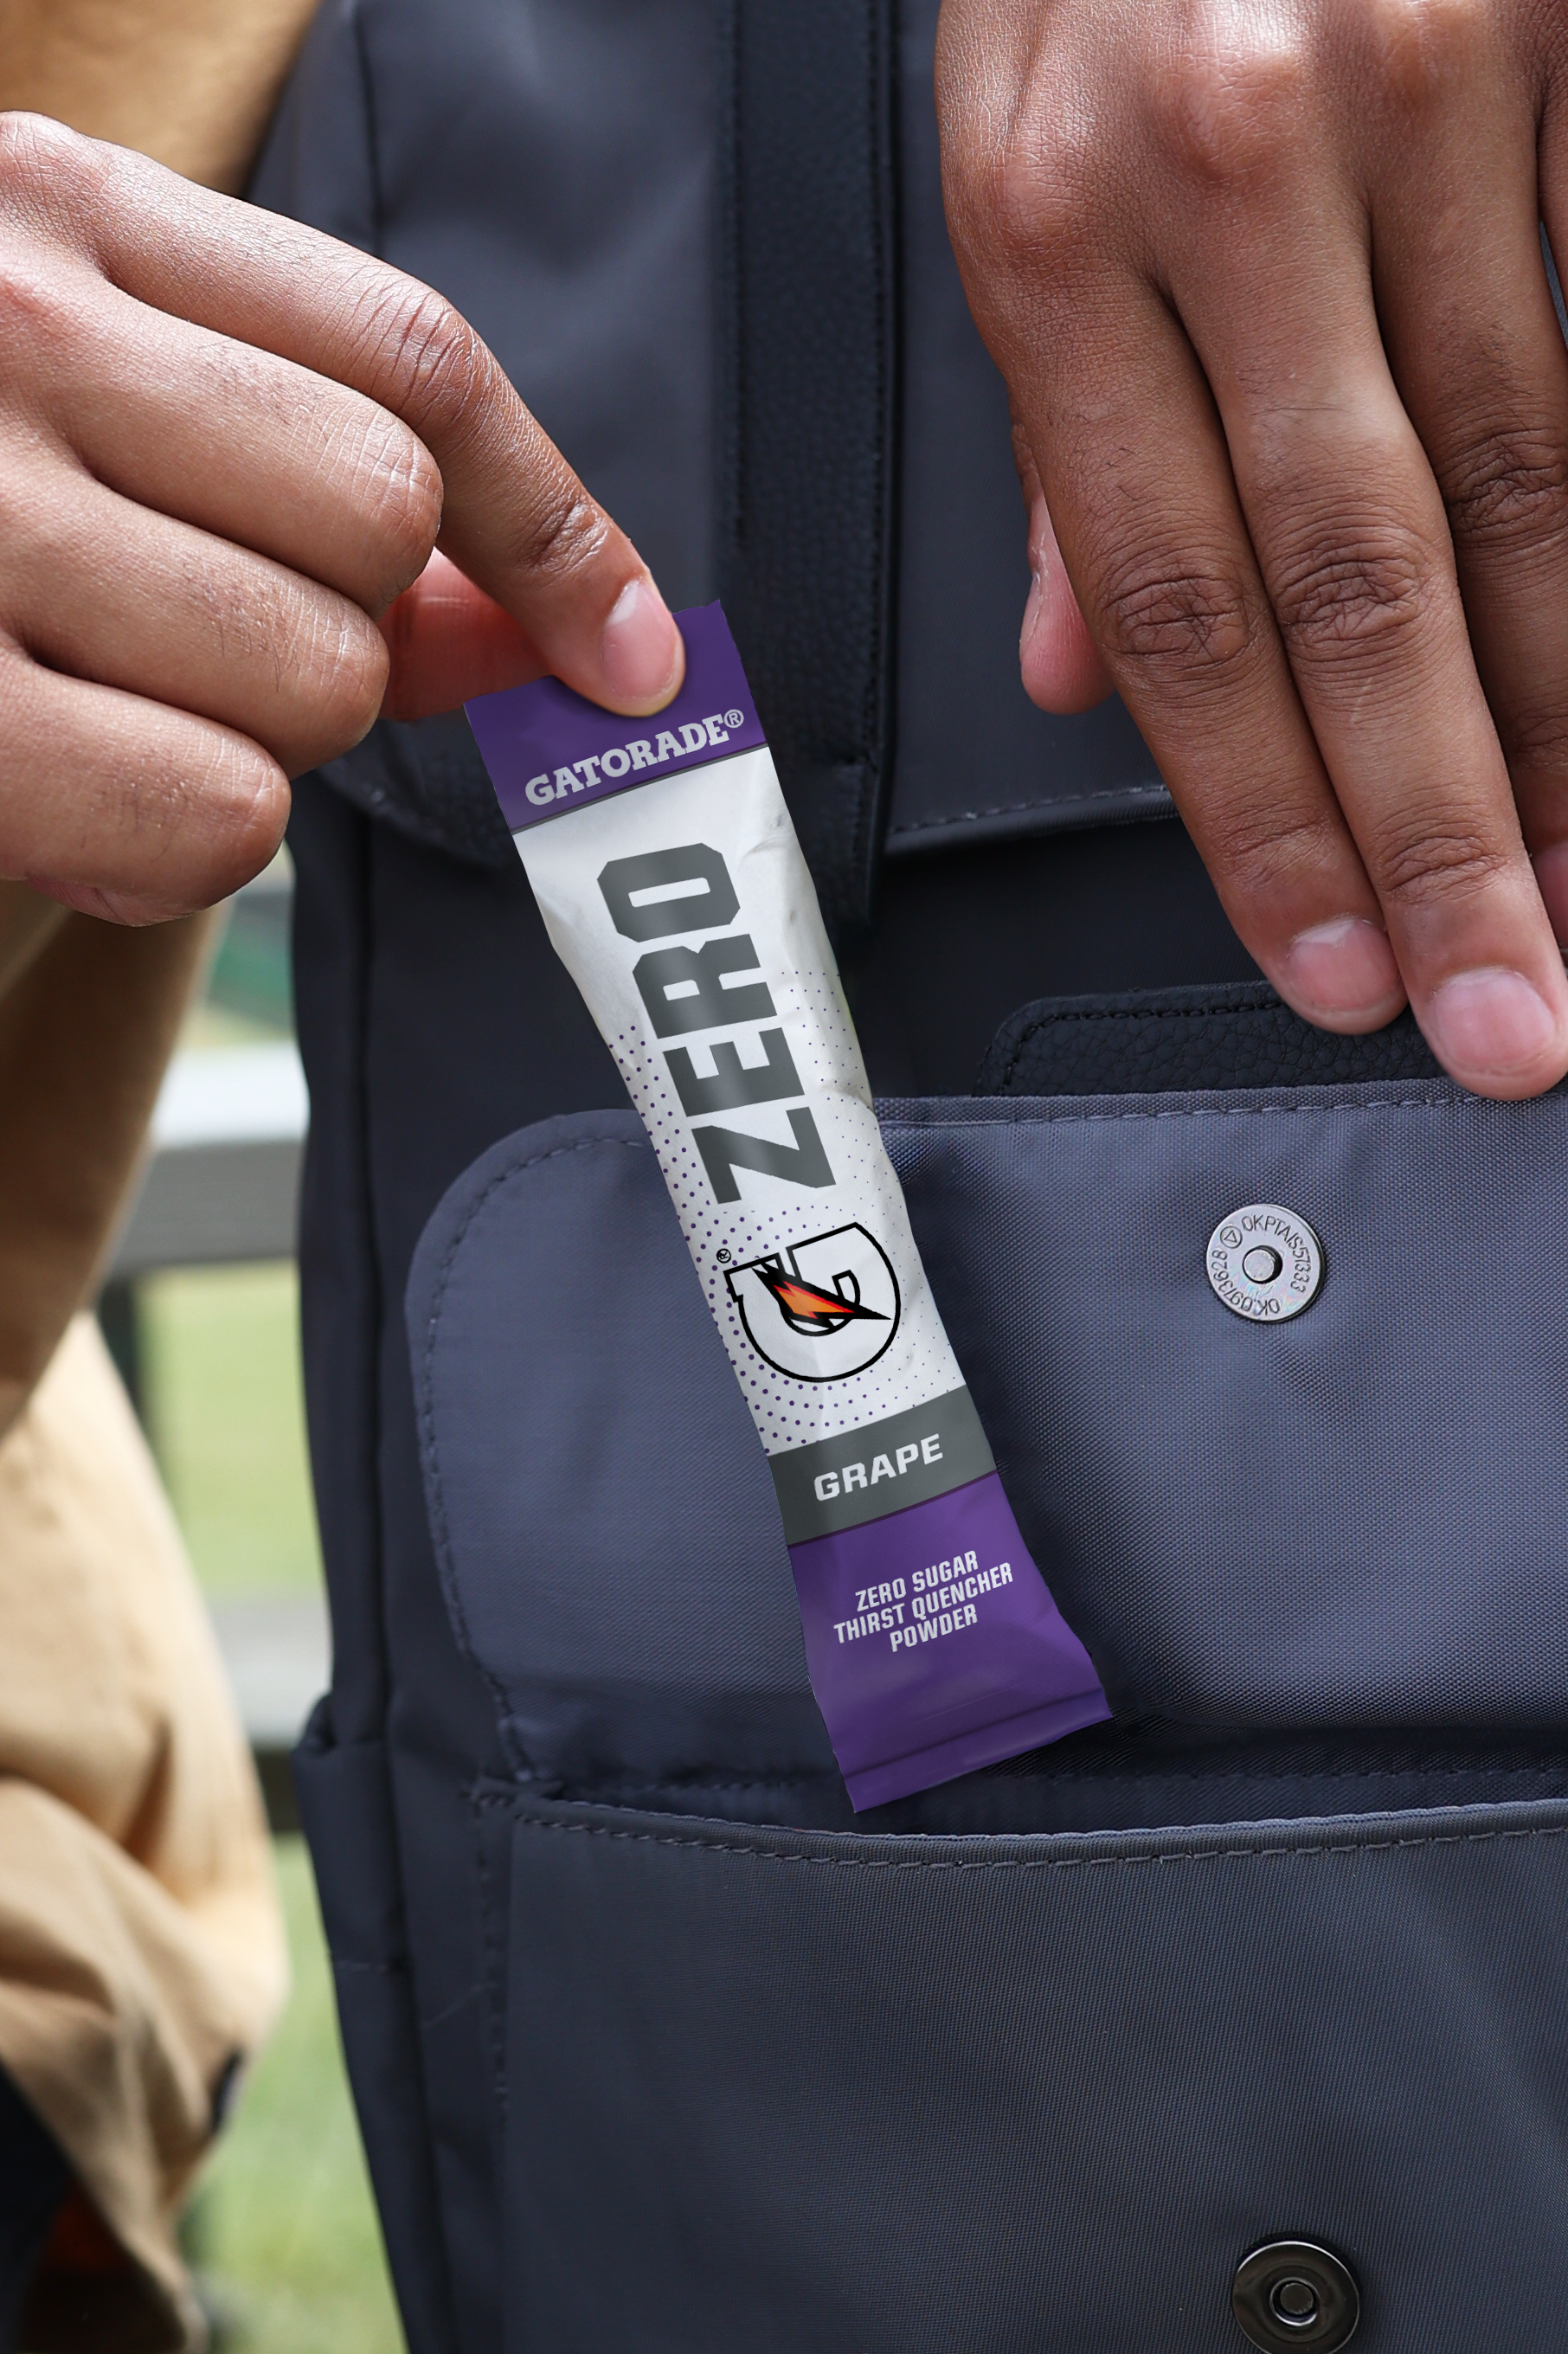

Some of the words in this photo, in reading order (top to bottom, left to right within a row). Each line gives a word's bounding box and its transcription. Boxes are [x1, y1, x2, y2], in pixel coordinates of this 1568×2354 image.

[597, 843, 836, 1204] ZERO
[813, 1433, 943, 1502] GRAPE
[833, 1603, 905, 1643] THIRST
[911, 1562, 1013, 1621] QUENCHER
[855, 1578, 906, 1611] ZERO
[911, 1550, 979, 1593] SUGAR
[889, 1603, 979, 1652] POWDER
